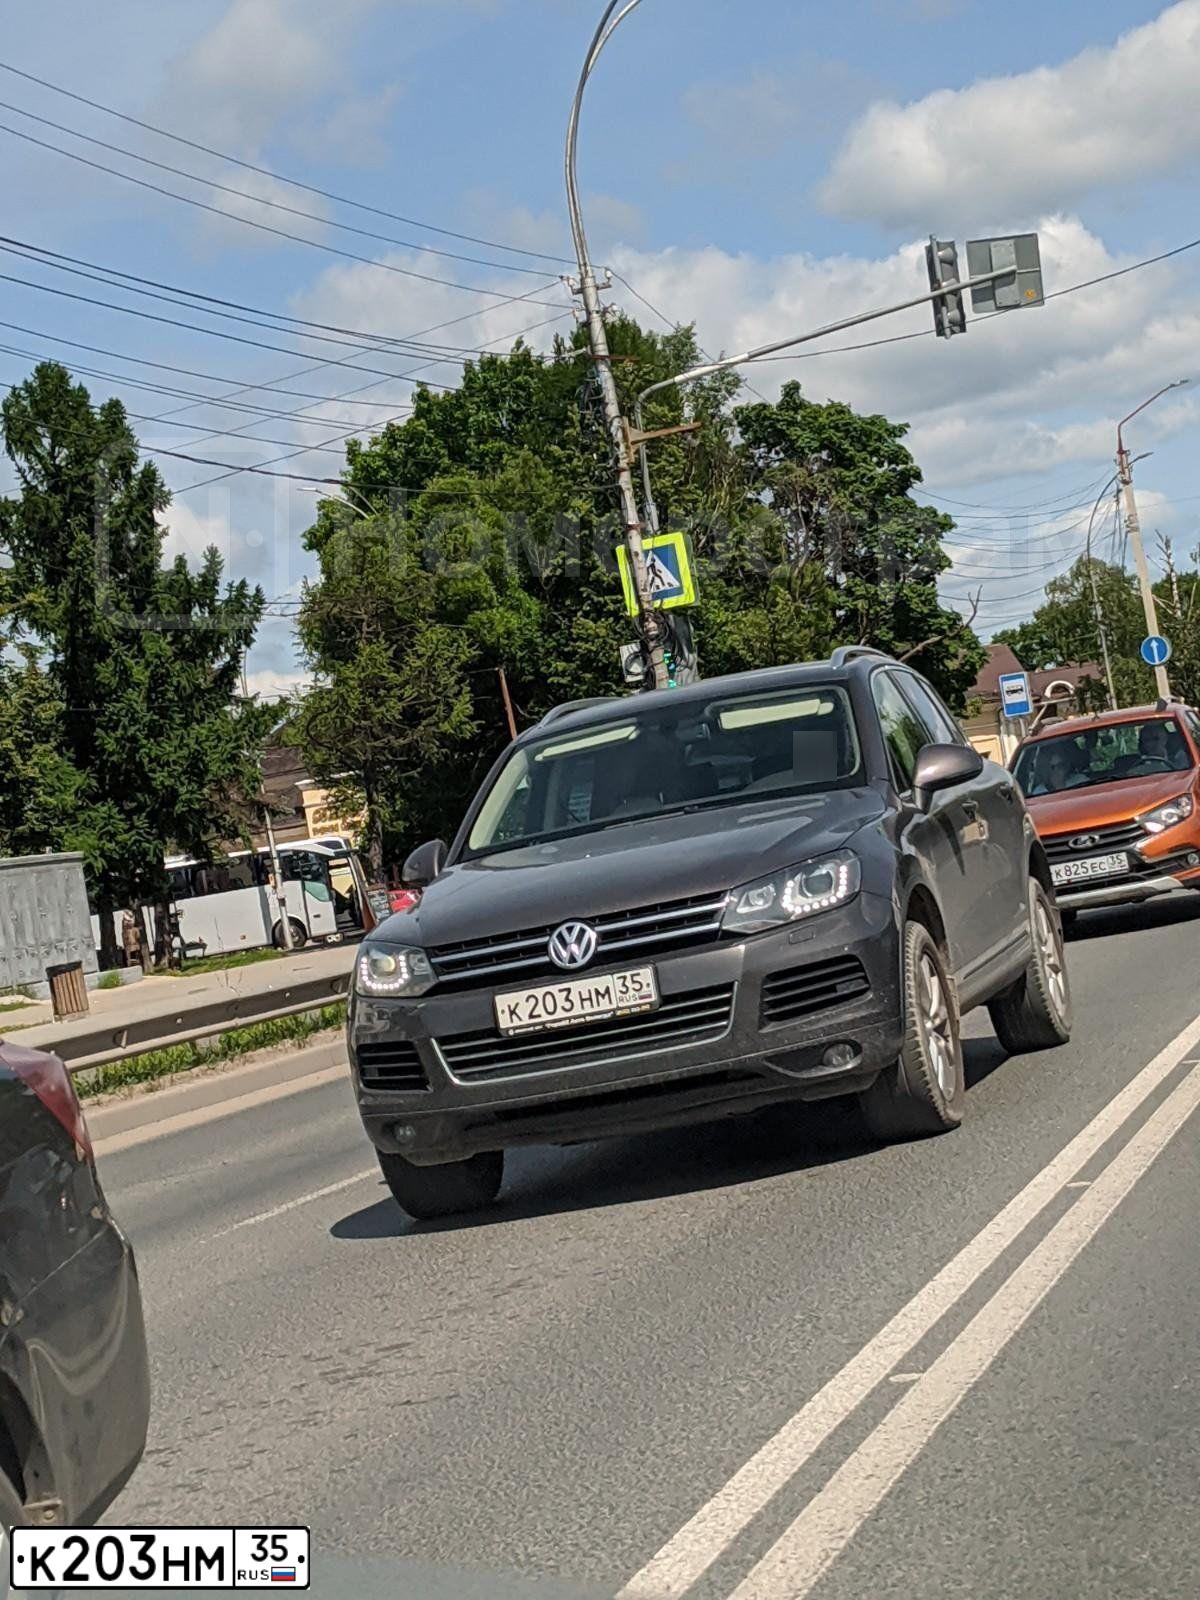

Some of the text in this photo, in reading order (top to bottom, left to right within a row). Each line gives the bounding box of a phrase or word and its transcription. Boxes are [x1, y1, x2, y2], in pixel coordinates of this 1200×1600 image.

[508, 985, 613, 1024] К203НМ
[617, 972, 644, 996] 35
[618, 993, 639, 1005] RUS
